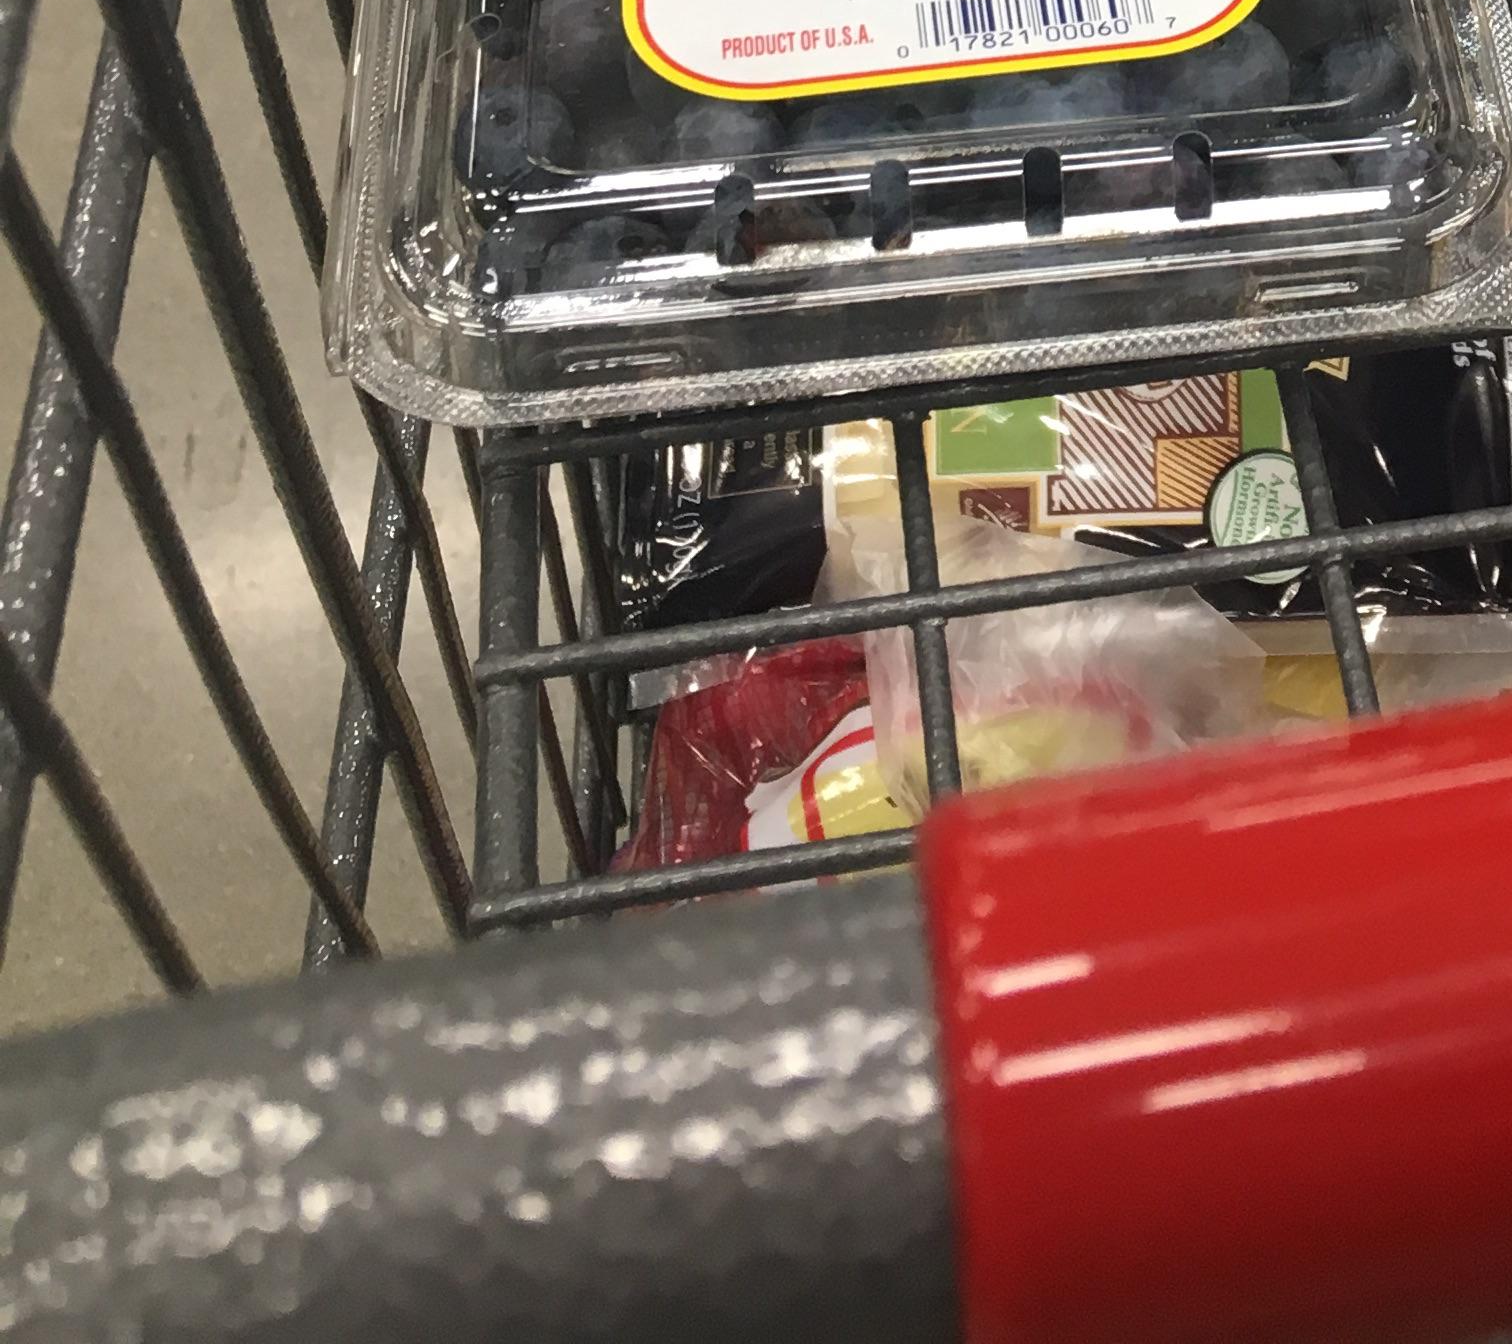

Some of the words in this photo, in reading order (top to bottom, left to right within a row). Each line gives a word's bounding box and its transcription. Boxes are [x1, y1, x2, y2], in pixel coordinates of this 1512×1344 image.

[720, 30, 796, 60] PRODUCT
[799, 29, 823, 50] OF
[824, 24, 875, 48] U.S.A.
[949, 28, 1030, 52] 17821
[1045, 18, 1130, 42] 00060
[1165, 15, 1177, 30] 7
